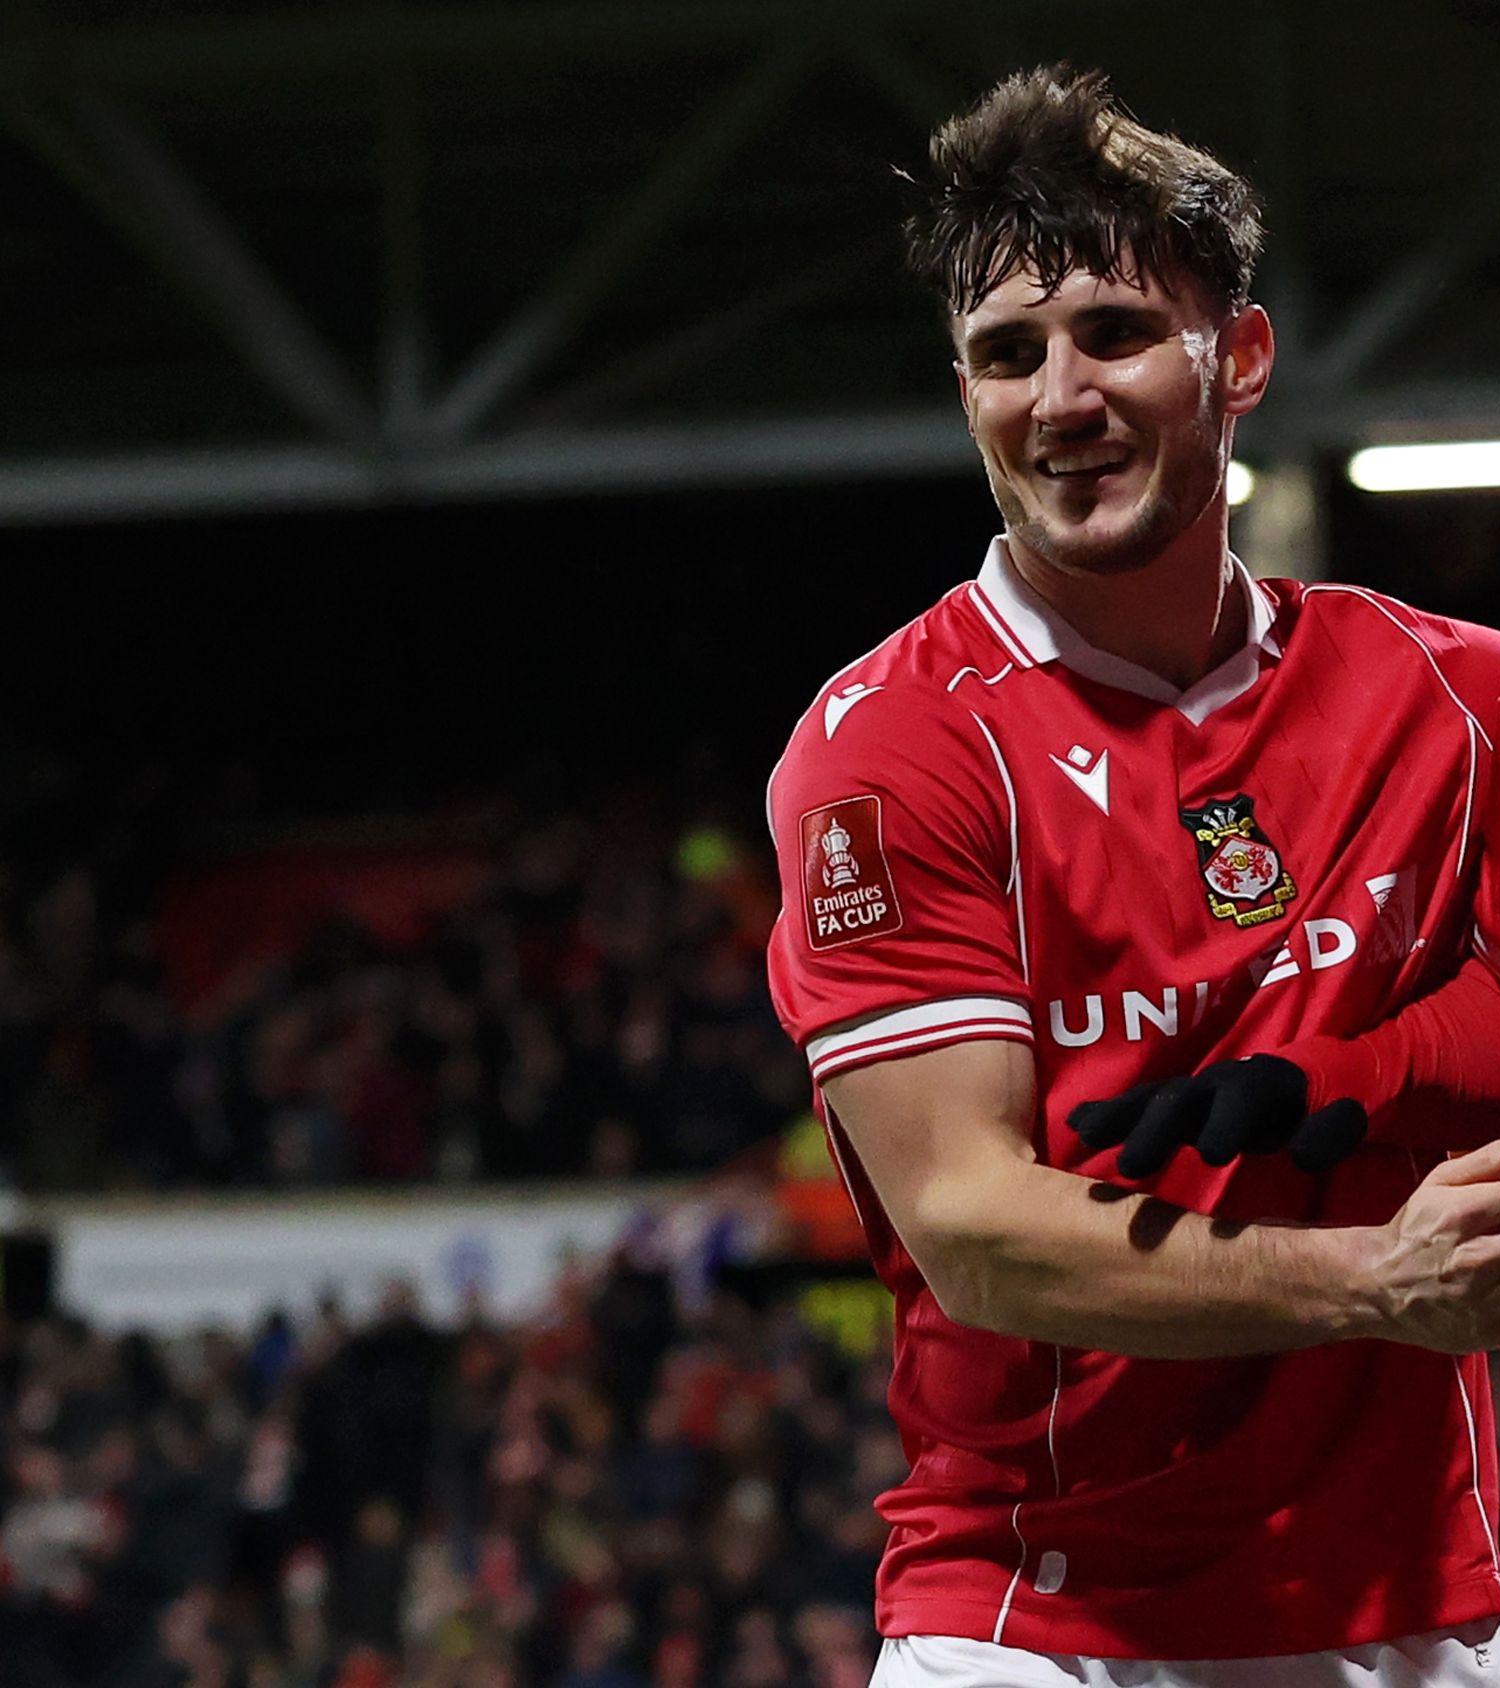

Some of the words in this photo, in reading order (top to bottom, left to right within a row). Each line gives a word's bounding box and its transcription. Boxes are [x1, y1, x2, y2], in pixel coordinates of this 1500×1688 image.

[813, 884, 883, 915] Emirates
[816, 914, 842, 937] FA
[844, 902, 888, 928] CUP
[1049, 916, 1358, 1048] UNIED
